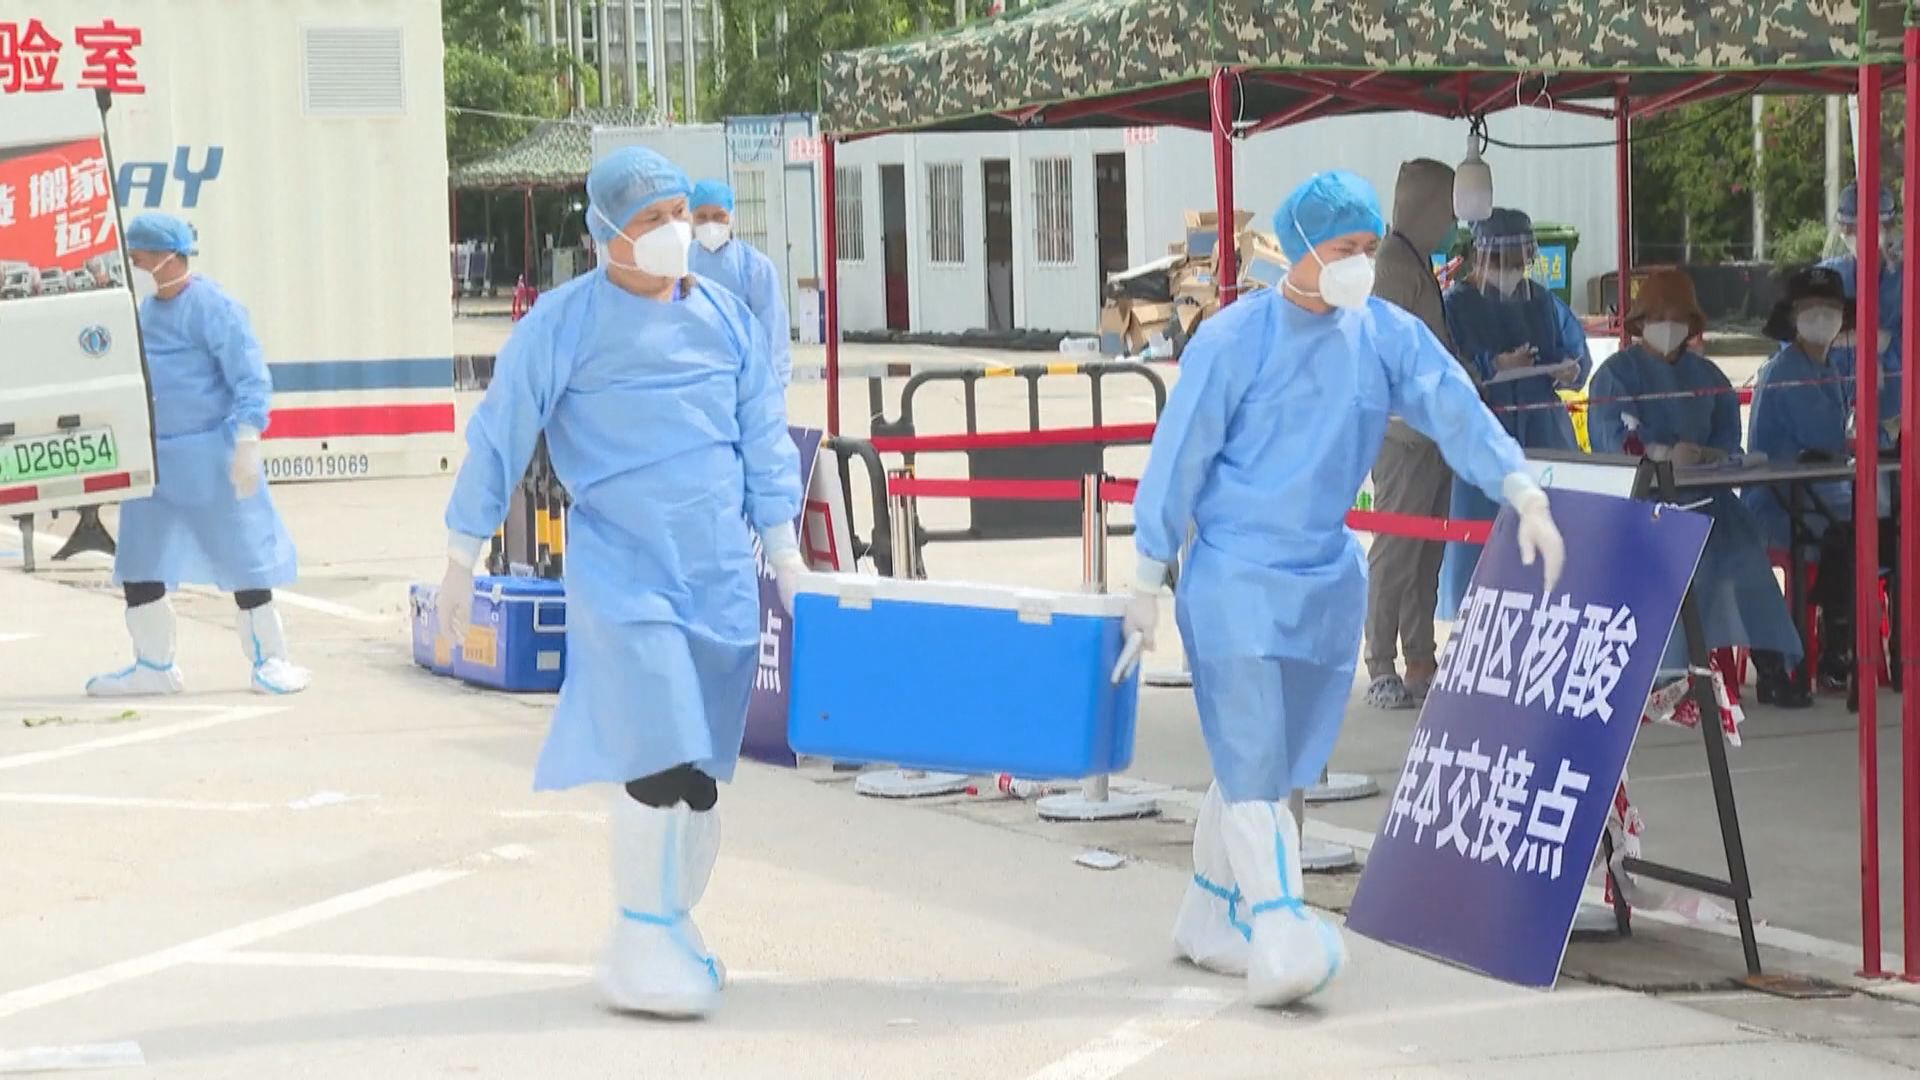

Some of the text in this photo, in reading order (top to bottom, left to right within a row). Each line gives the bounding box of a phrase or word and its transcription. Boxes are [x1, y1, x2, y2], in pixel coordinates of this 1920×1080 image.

[0, 18, 145, 93] 验室
[1384, 728, 1591, 880] 样本交接点
